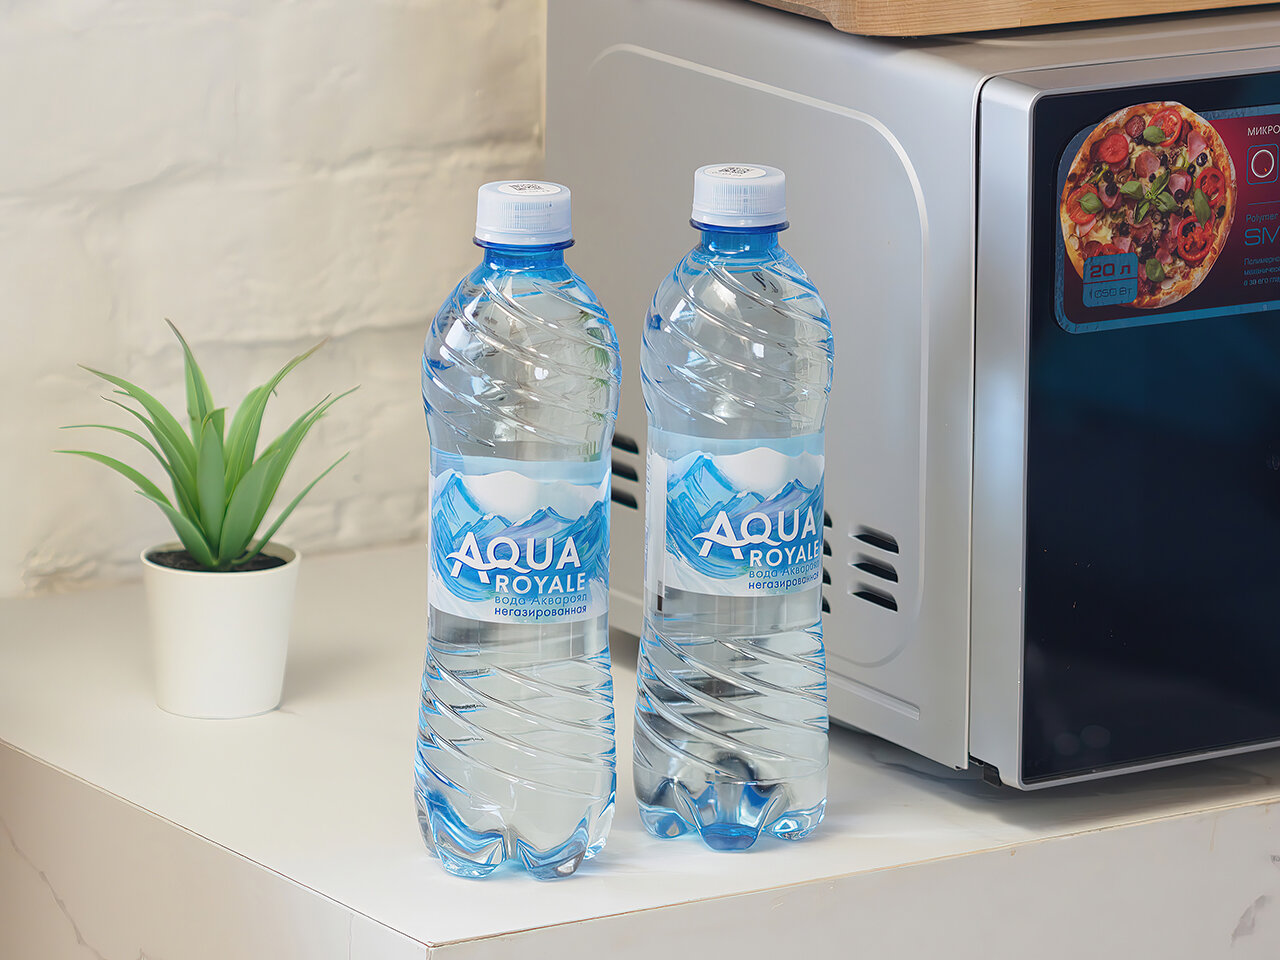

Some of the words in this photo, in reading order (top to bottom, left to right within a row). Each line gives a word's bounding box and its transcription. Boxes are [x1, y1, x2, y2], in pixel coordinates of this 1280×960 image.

[1245, 214, 1278, 224] Polymer
[1090, 263, 1115, 278] 20
[1120, 264, 1131, 275] л
[691, 506, 817, 559] AQUA
[446, 532, 582, 584] AQUA
[749, 540, 819, 567] ROYALE
[749, 569, 778, 578] вода
[495, 572, 586, 594] ROYALE
[494, 595, 526, 606] вода
[530, 594, 588, 607] Аквароял
[494, 605, 588, 620] негазированная
